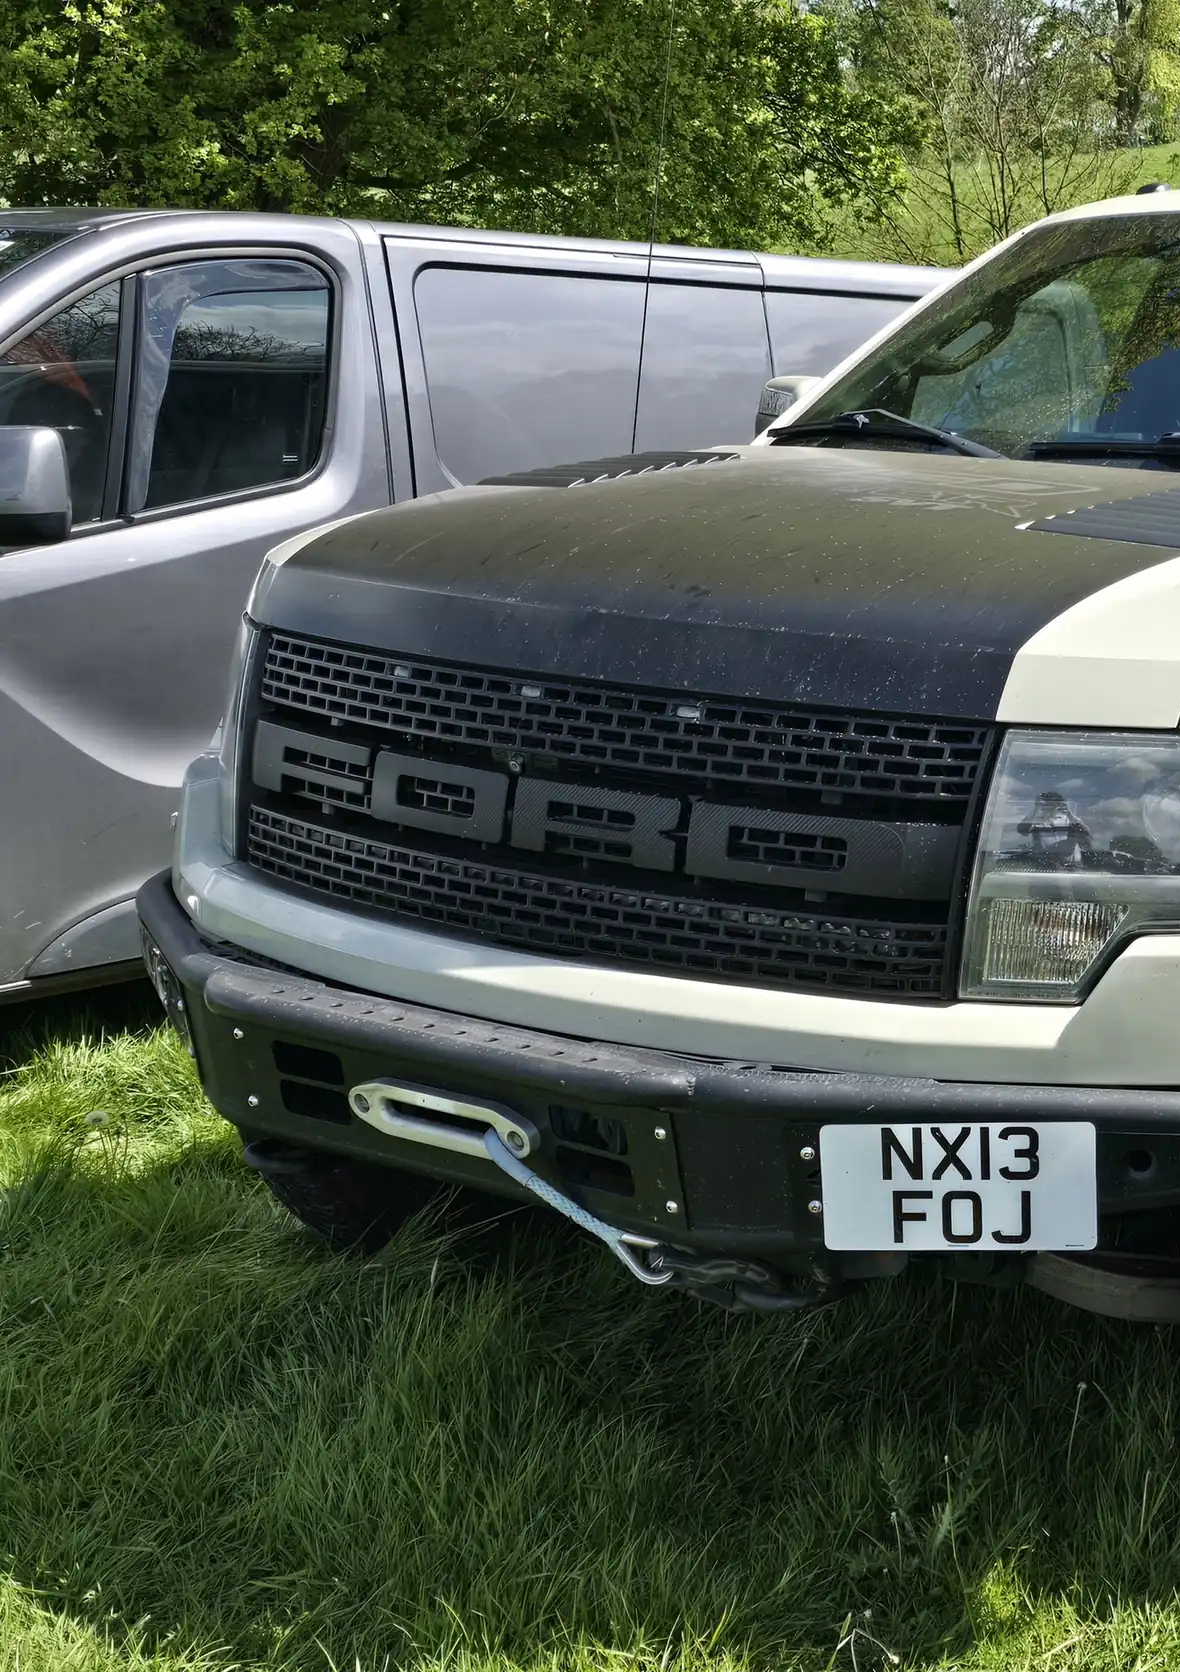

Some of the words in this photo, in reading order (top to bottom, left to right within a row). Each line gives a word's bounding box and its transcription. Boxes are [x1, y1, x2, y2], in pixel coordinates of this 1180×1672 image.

[250, 718, 908, 895] FORD
[881, 1126, 1040, 1180] NX13
[892, 1190, 1032, 1243] FOJ
